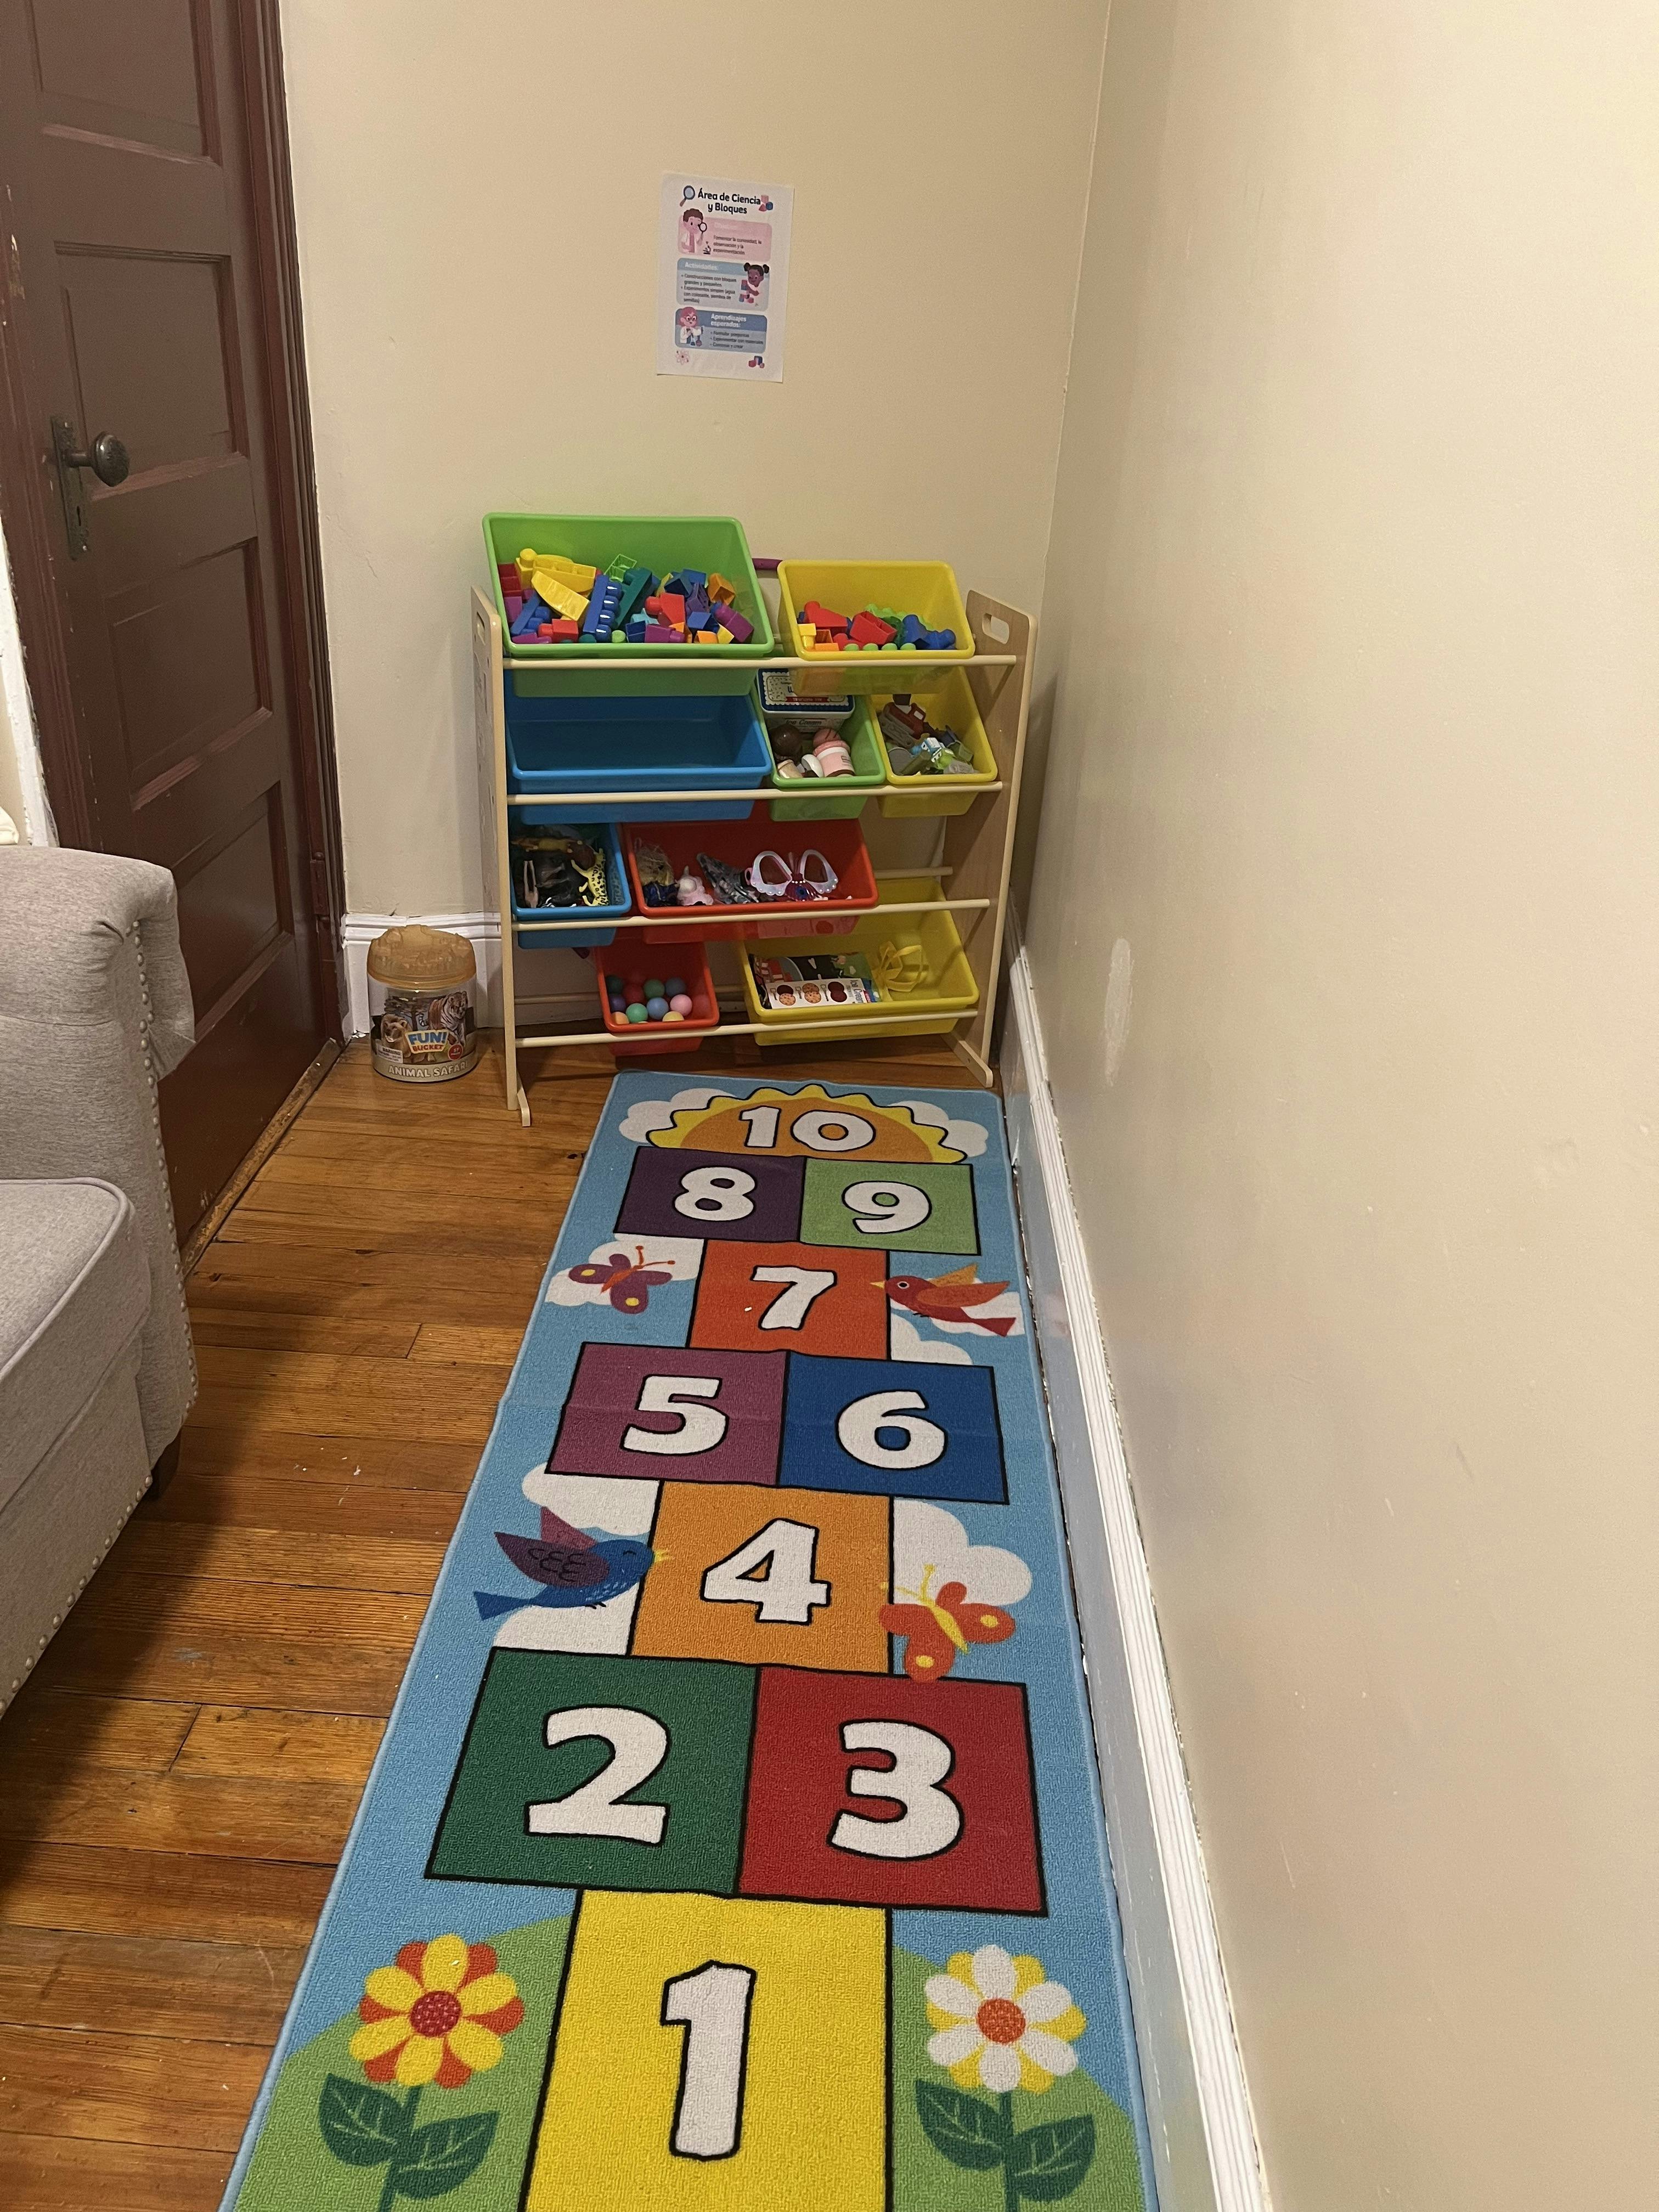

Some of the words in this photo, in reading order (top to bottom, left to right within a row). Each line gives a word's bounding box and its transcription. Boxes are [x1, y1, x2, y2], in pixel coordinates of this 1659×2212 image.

[698, 188, 718, 200] Área
[720, 193, 730, 201] de
[732, 194, 761, 205] Ciencia
[708, 204, 713, 213] y
[715, 202, 747, 215] Bloques
[711, 313, 747, 322] Aprendizajes
[408, 1031, 448, 1045] FUN!
[388, 1065, 431, 1077] ANIMAL
[740, 1104, 876, 1152] 10
[674, 1165, 757, 1222] 8
[842, 1180, 932, 1234] 9
[751, 1265, 837, 1331] 7
[620, 1374, 729, 1456] 5
[836, 1390, 947, 1470] 6
[700, 1517, 832, 1625] 4
[524, 1704, 671, 1846] 2
[827, 1718, 964, 1861] 3
[659, 1960, 757, 2160] 1
